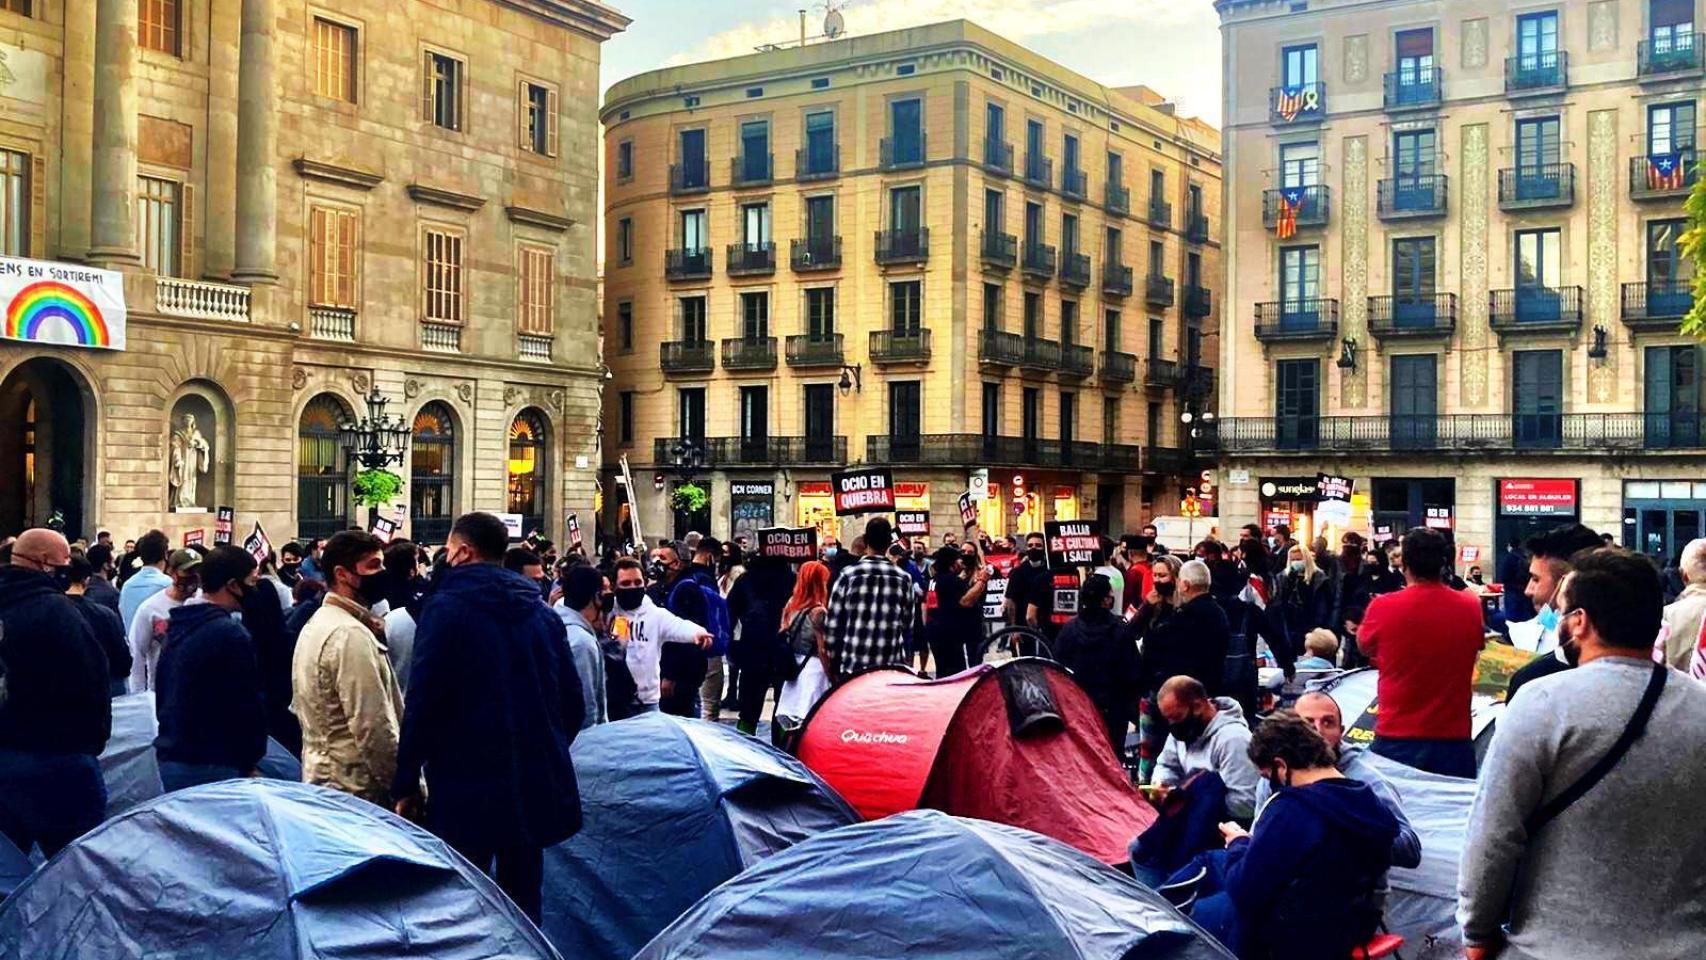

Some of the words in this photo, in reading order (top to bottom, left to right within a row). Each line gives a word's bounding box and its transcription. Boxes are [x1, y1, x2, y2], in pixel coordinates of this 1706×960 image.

[28, 266, 43, 277] EN
[841, 475, 868, 491] OCIO
[870, 475, 885, 488] EN
[732, 485, 745, 494] BCN
[746, 485, 772, 494] CORNER
[841, 490, 889, 508] QUIEBRA
[899, 513, 914, 523] OCIO
[916, 513, 925, 522] EN
[1060, 525, 1090, 536] BALLAR
[767, 533, 791, 544] OCIO
[794, 533, 808, 544] EN
[1051, 536, 1064, 551] ÉS
[1066, 537, 1100, 550] CULTURA
[766, 545, 811, 557] QUIEBRA
[1063, 552, 1067, 562] I
[1069, 551, 1092, 562] SALUT
